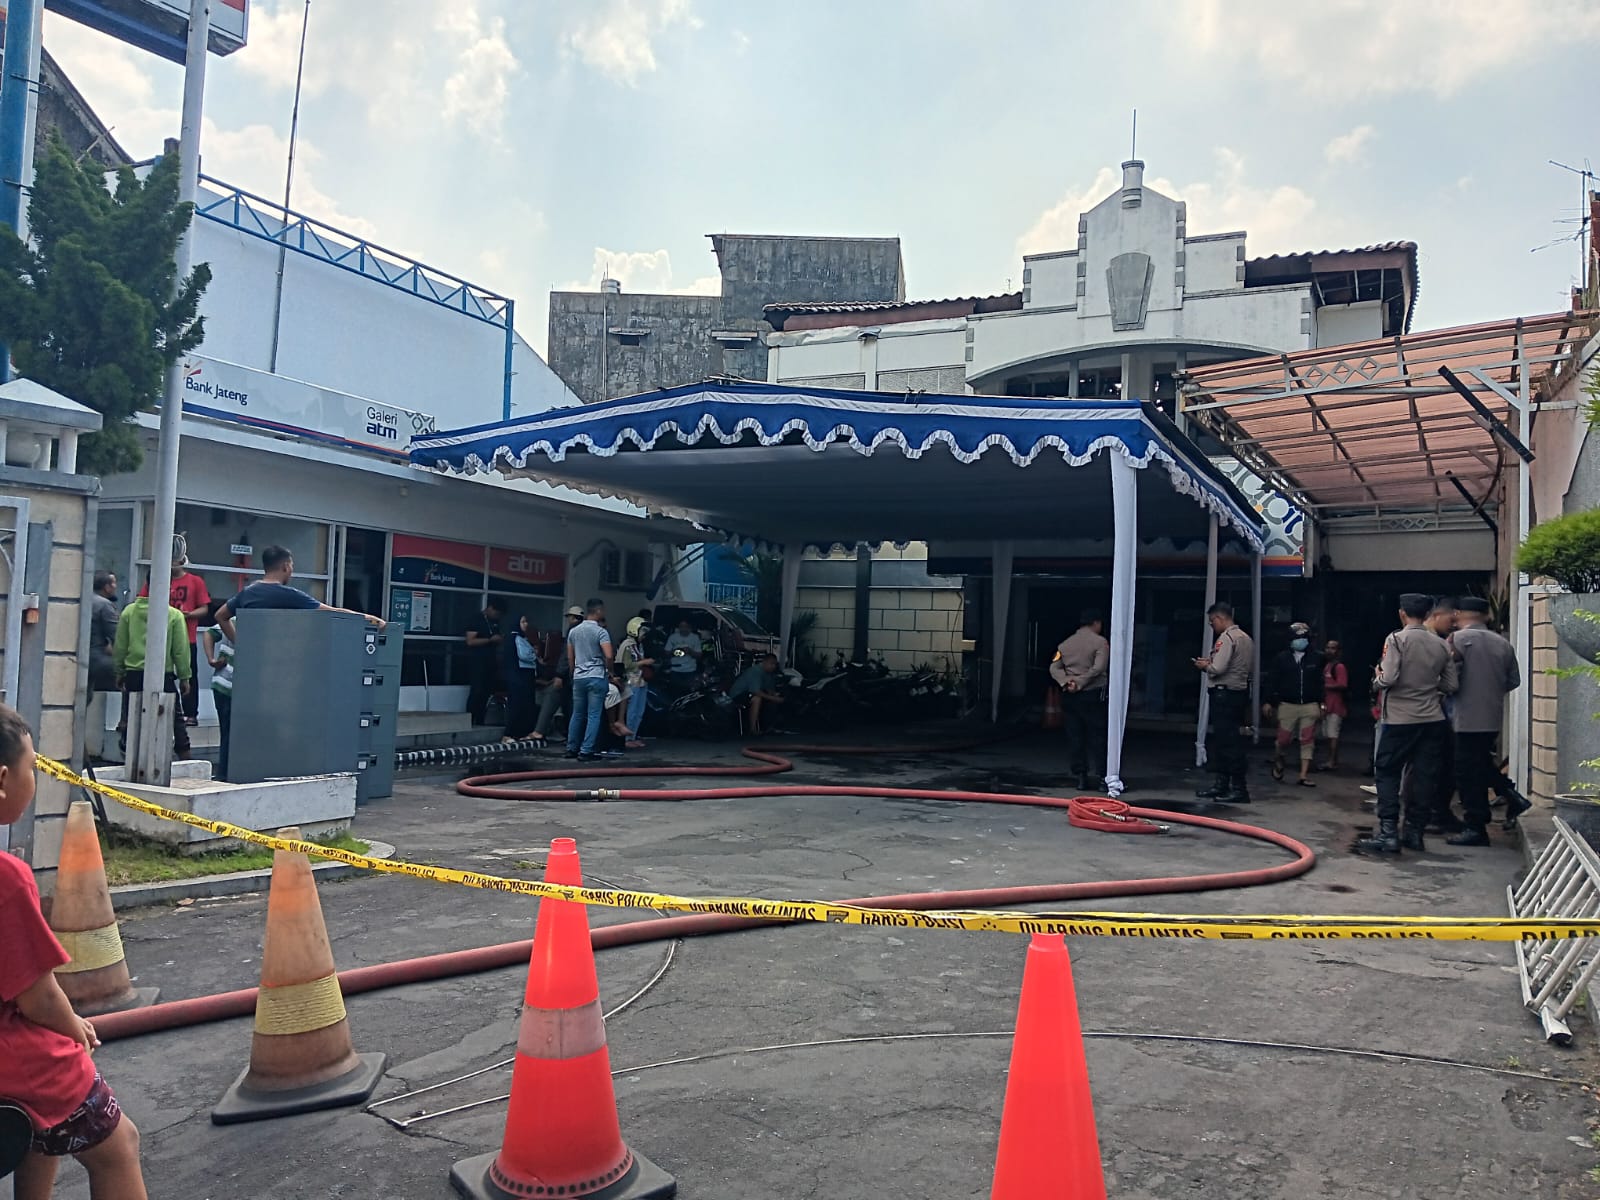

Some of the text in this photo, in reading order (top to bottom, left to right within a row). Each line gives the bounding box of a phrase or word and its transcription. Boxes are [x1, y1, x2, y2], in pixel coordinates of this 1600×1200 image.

[185, 377, 248, 405] Bank Jateng
[366, 406, 398, 425] Galeri
[366, 422, 397, 440] atm
[508, 554, 546, 575] atm
